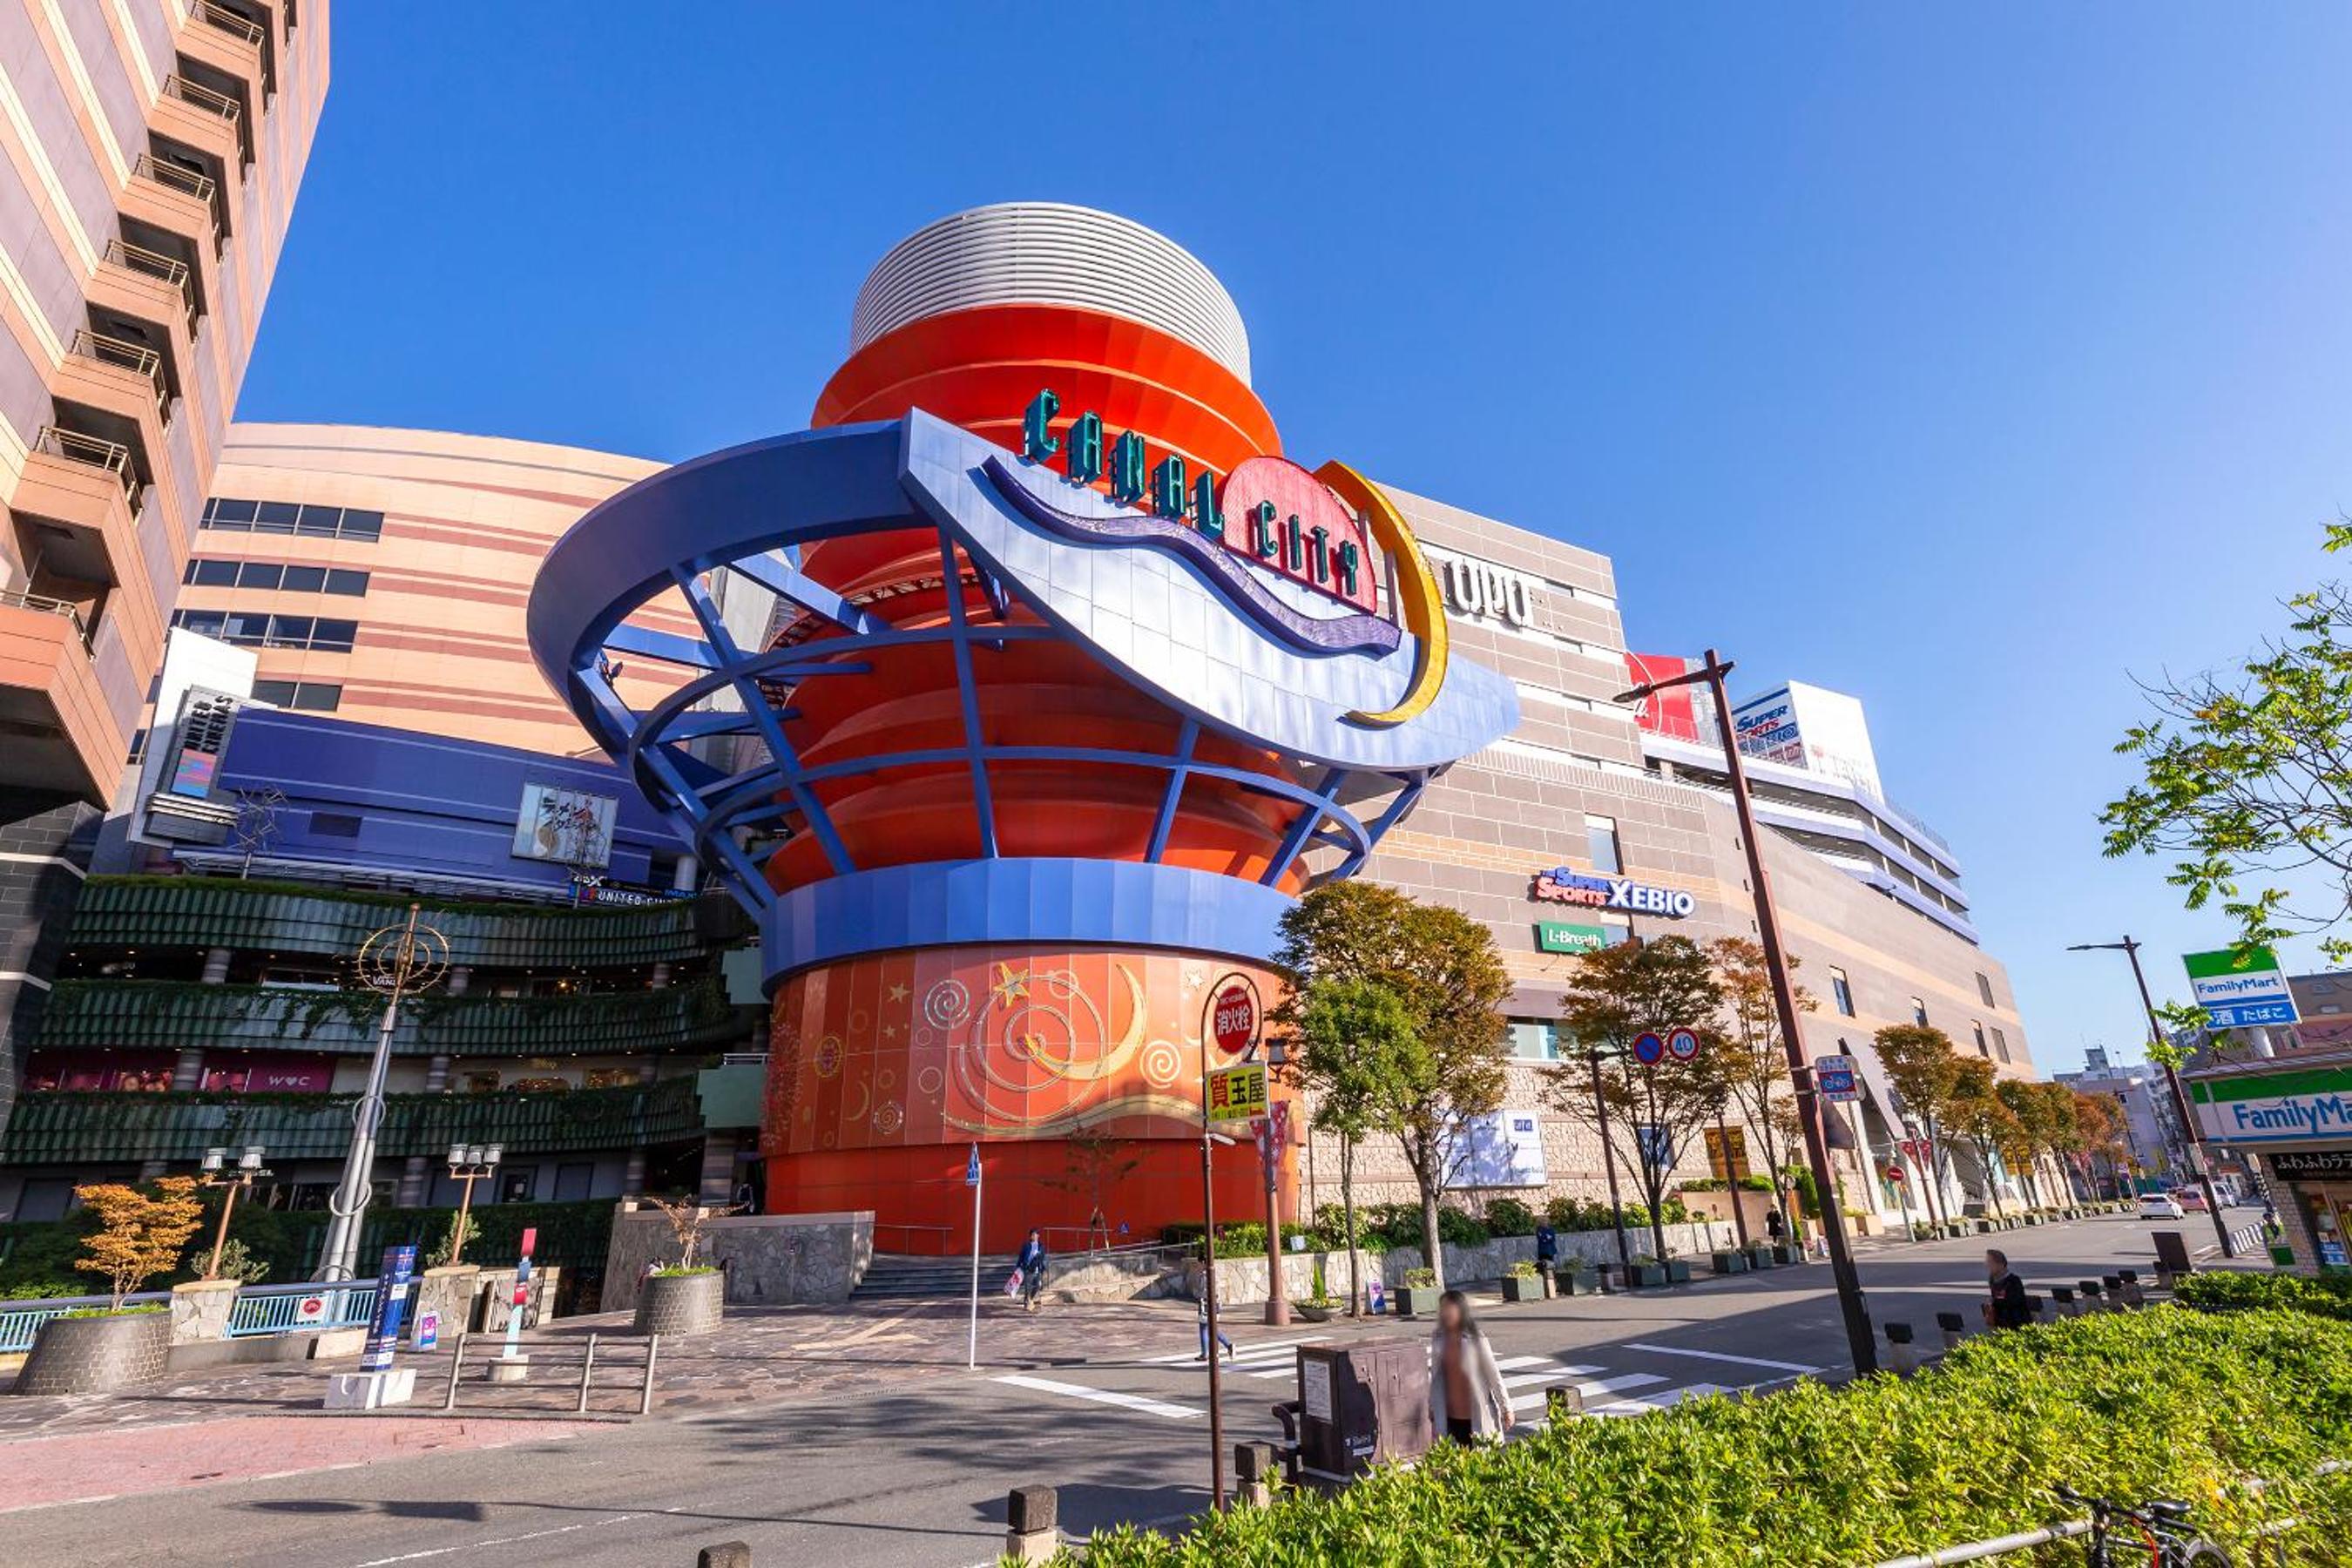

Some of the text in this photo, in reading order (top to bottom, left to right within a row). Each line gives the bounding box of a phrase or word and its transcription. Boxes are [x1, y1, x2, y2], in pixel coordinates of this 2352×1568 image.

[1023, 388, 1359, 597] CANAL CITY
[184, 700, 213, 750] UNITED
[201, 695, 233, 754] CINEMAS
[598, 890, 642, 906] UNITED
[1609, 881, 1695, 916] XEBIO
[1548, 929, 1602, 948] L-Breath
[2197, 977, 2279, 994] FamilyMart
[1216, 1004, 1251, 1036] 消火栓
[2241, 1006, 2288, 1023] たばこ
[1674, 1036, 1693, 1052] 40
